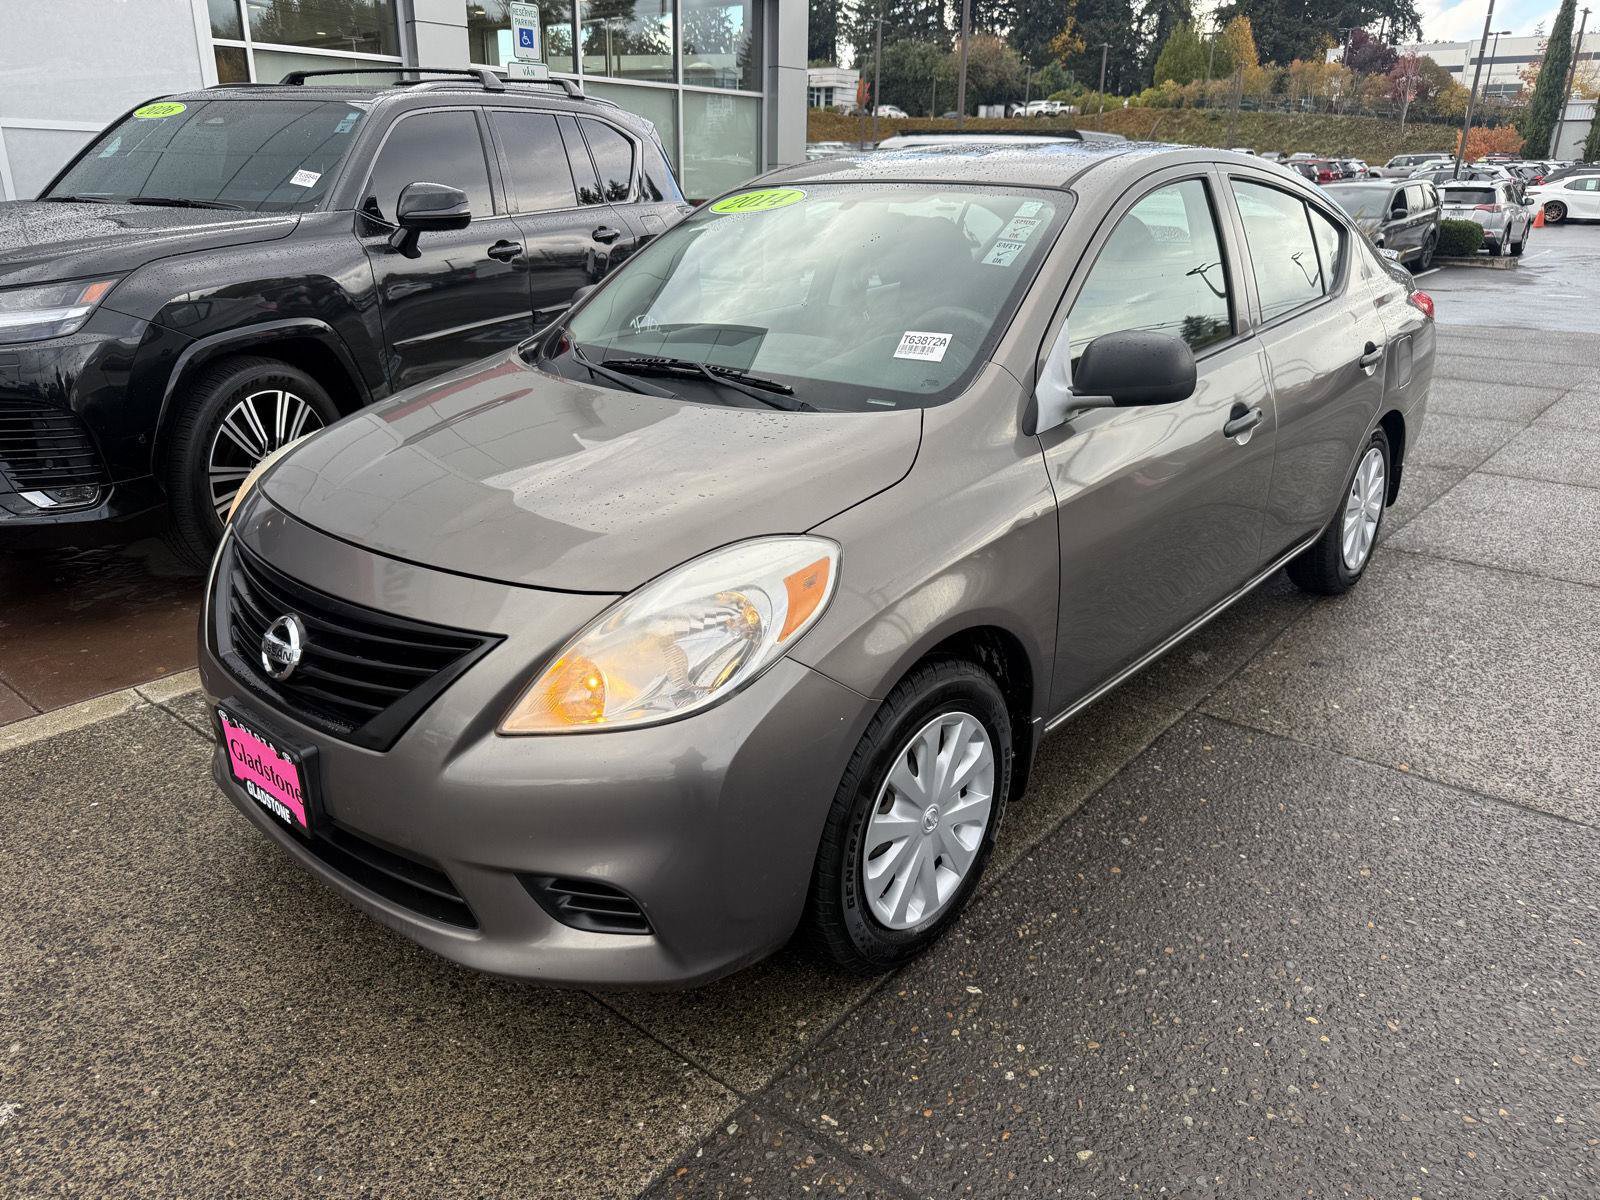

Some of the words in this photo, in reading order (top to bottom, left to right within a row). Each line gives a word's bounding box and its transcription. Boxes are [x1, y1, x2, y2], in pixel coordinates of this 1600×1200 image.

[512, 7, 537, 18] RESERVED
[514, 17, 537, 28] PARKING
[522, 68, 536, 77] VAN
[996, 242, 1023, 251] SAFETY
[903, 334, 948, 348] T63872A
[230, 738, 304, 806] Gladstone
[246, 780, 292, 825] GLADSTONE
